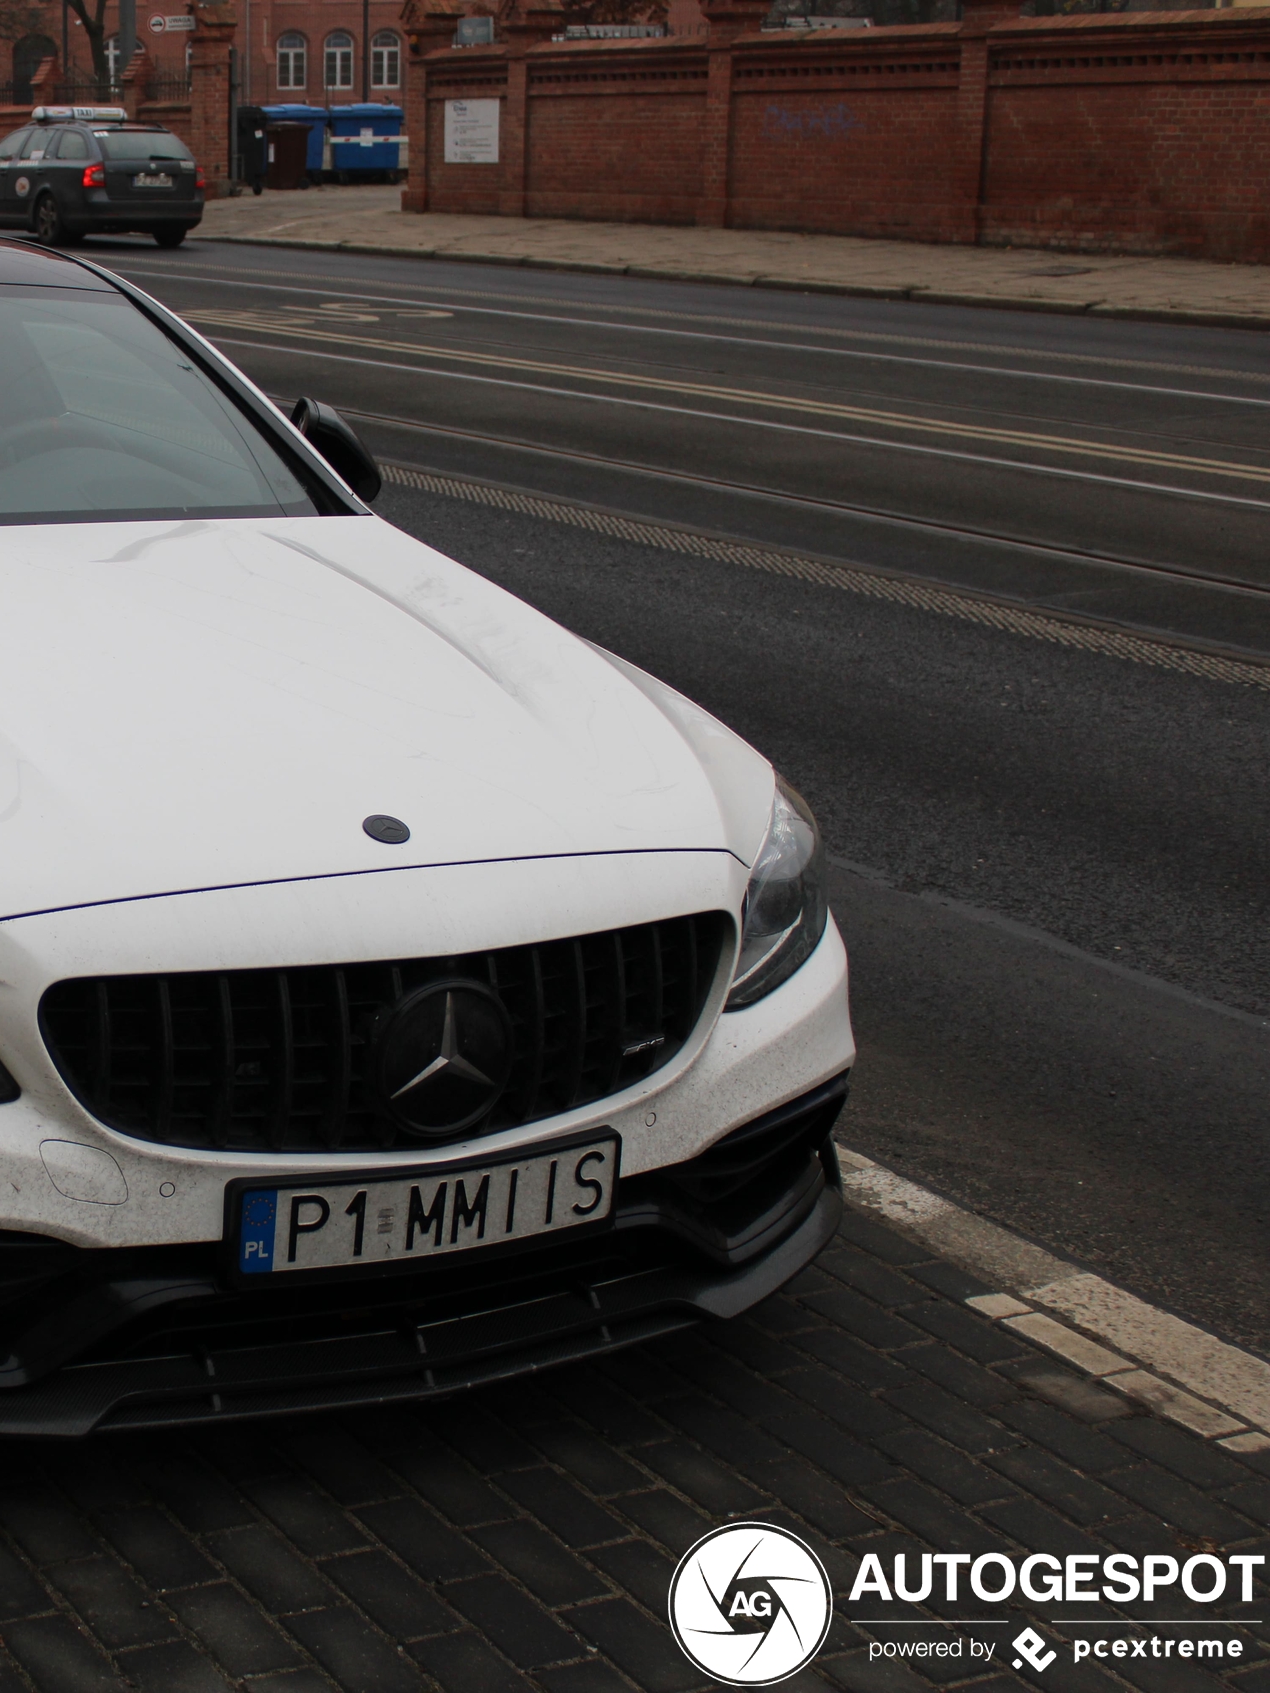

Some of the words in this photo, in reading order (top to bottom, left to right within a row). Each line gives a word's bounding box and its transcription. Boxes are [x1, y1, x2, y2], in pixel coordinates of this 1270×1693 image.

[76, 108, 92, 117] TAXI
[287, 1189, 369, 1263] P1
[244, 1241, 269, 1259] PL
